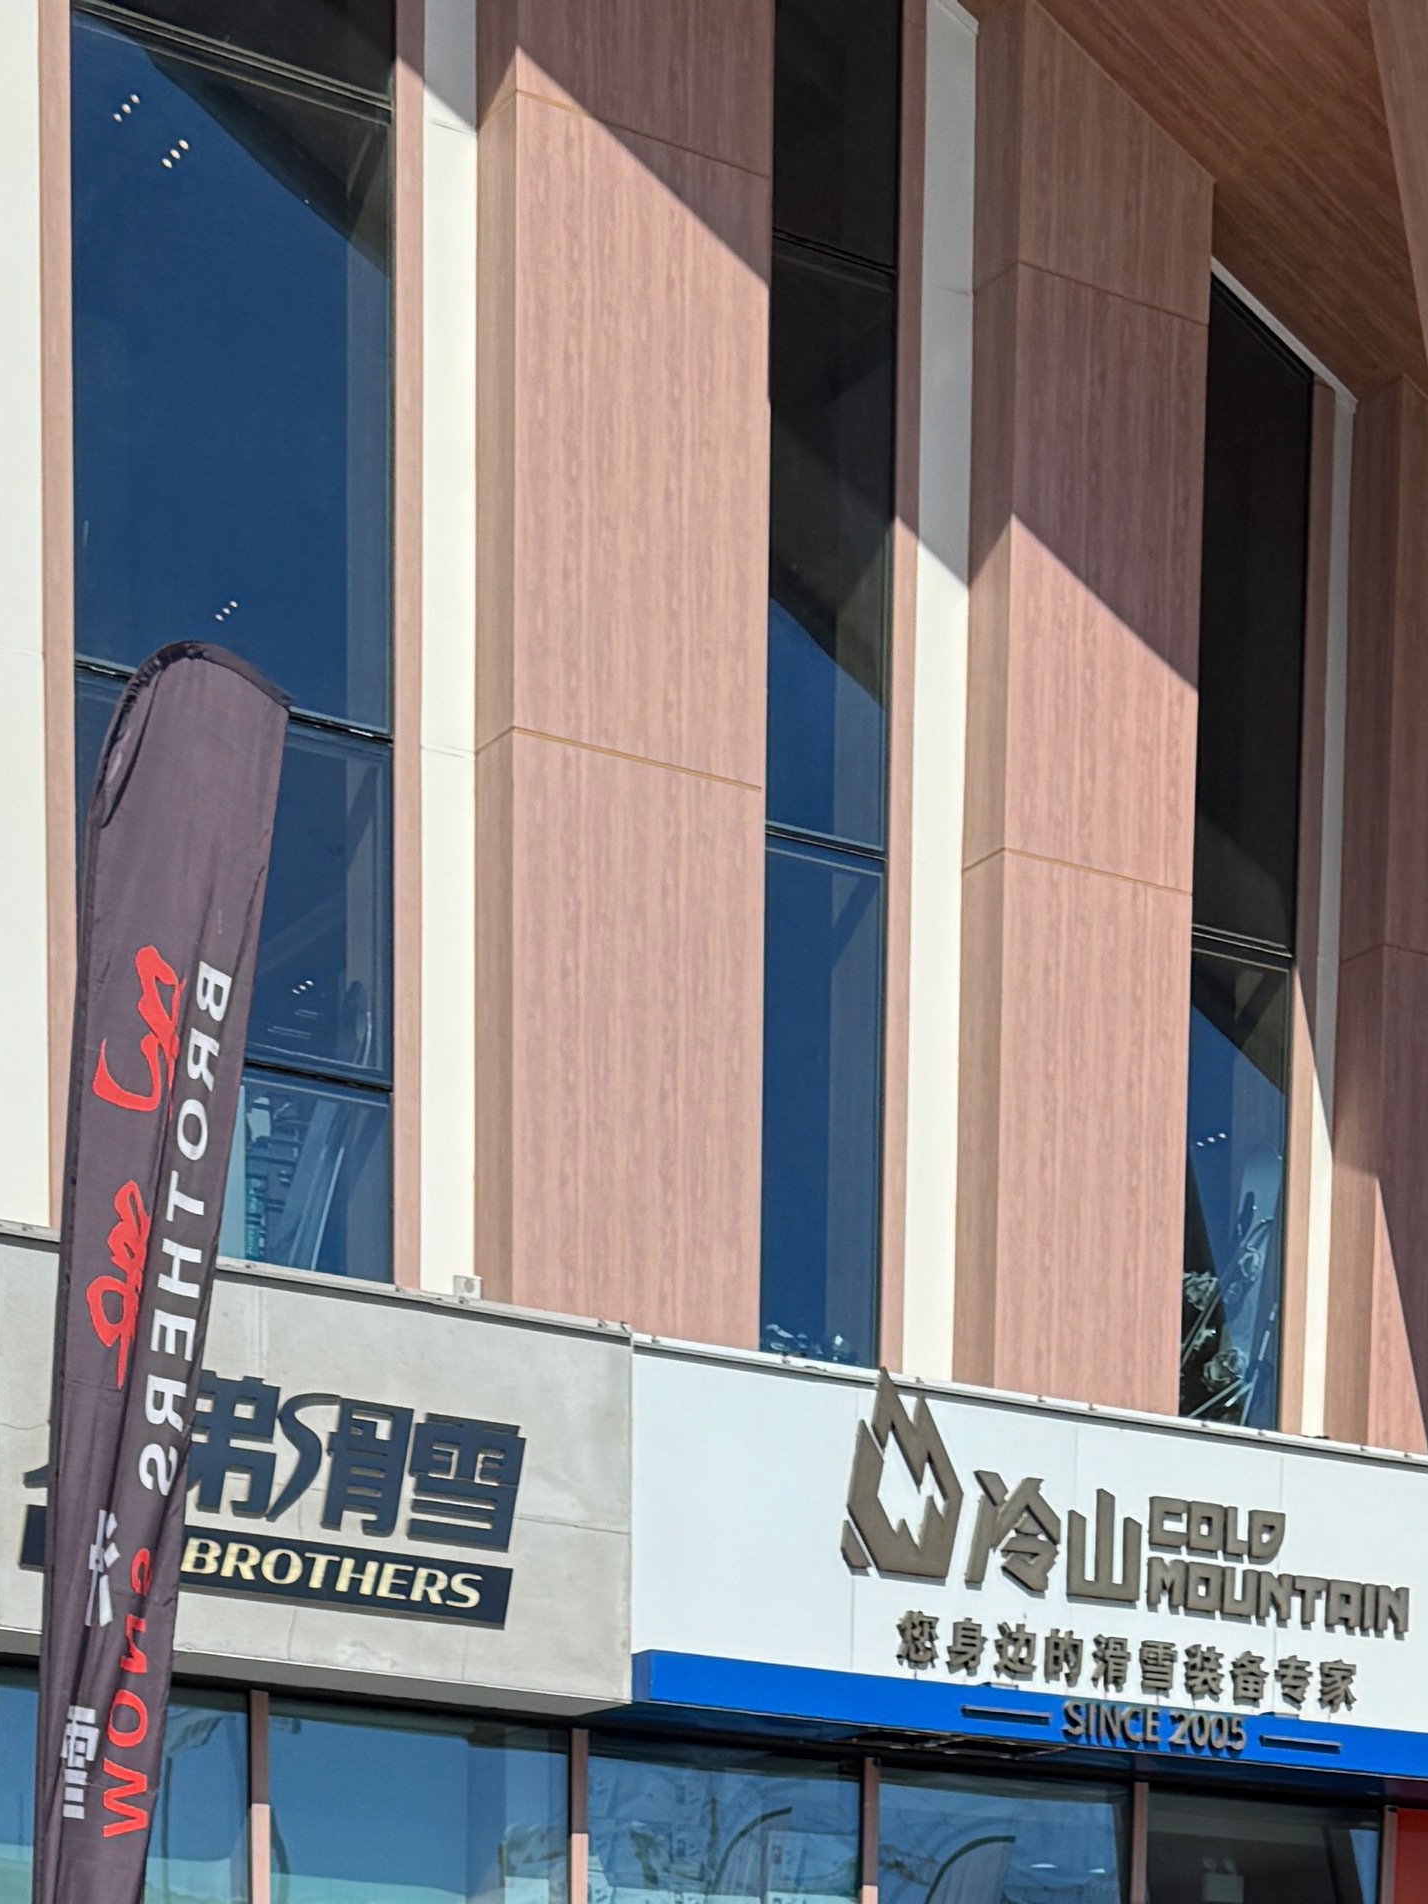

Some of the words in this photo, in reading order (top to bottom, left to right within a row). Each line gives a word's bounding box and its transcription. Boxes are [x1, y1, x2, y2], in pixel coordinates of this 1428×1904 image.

[184, 1367, 526, 1552] 弟滑雪
[965, 1470, 1142, 1606] 冷山
[1148, 1494, 1287, 1565] COLD
[180, 1535, 482, 1609] BROTHERS
[1146, 1556, 1410, 1636] MOUNTAIN
[895, 1610, 1358, 1713] 您身边的滑雪装备专家
[1061, 1701, 1161, 1748] SINCE
[1169, 1711, 1247, 1754] 2005
